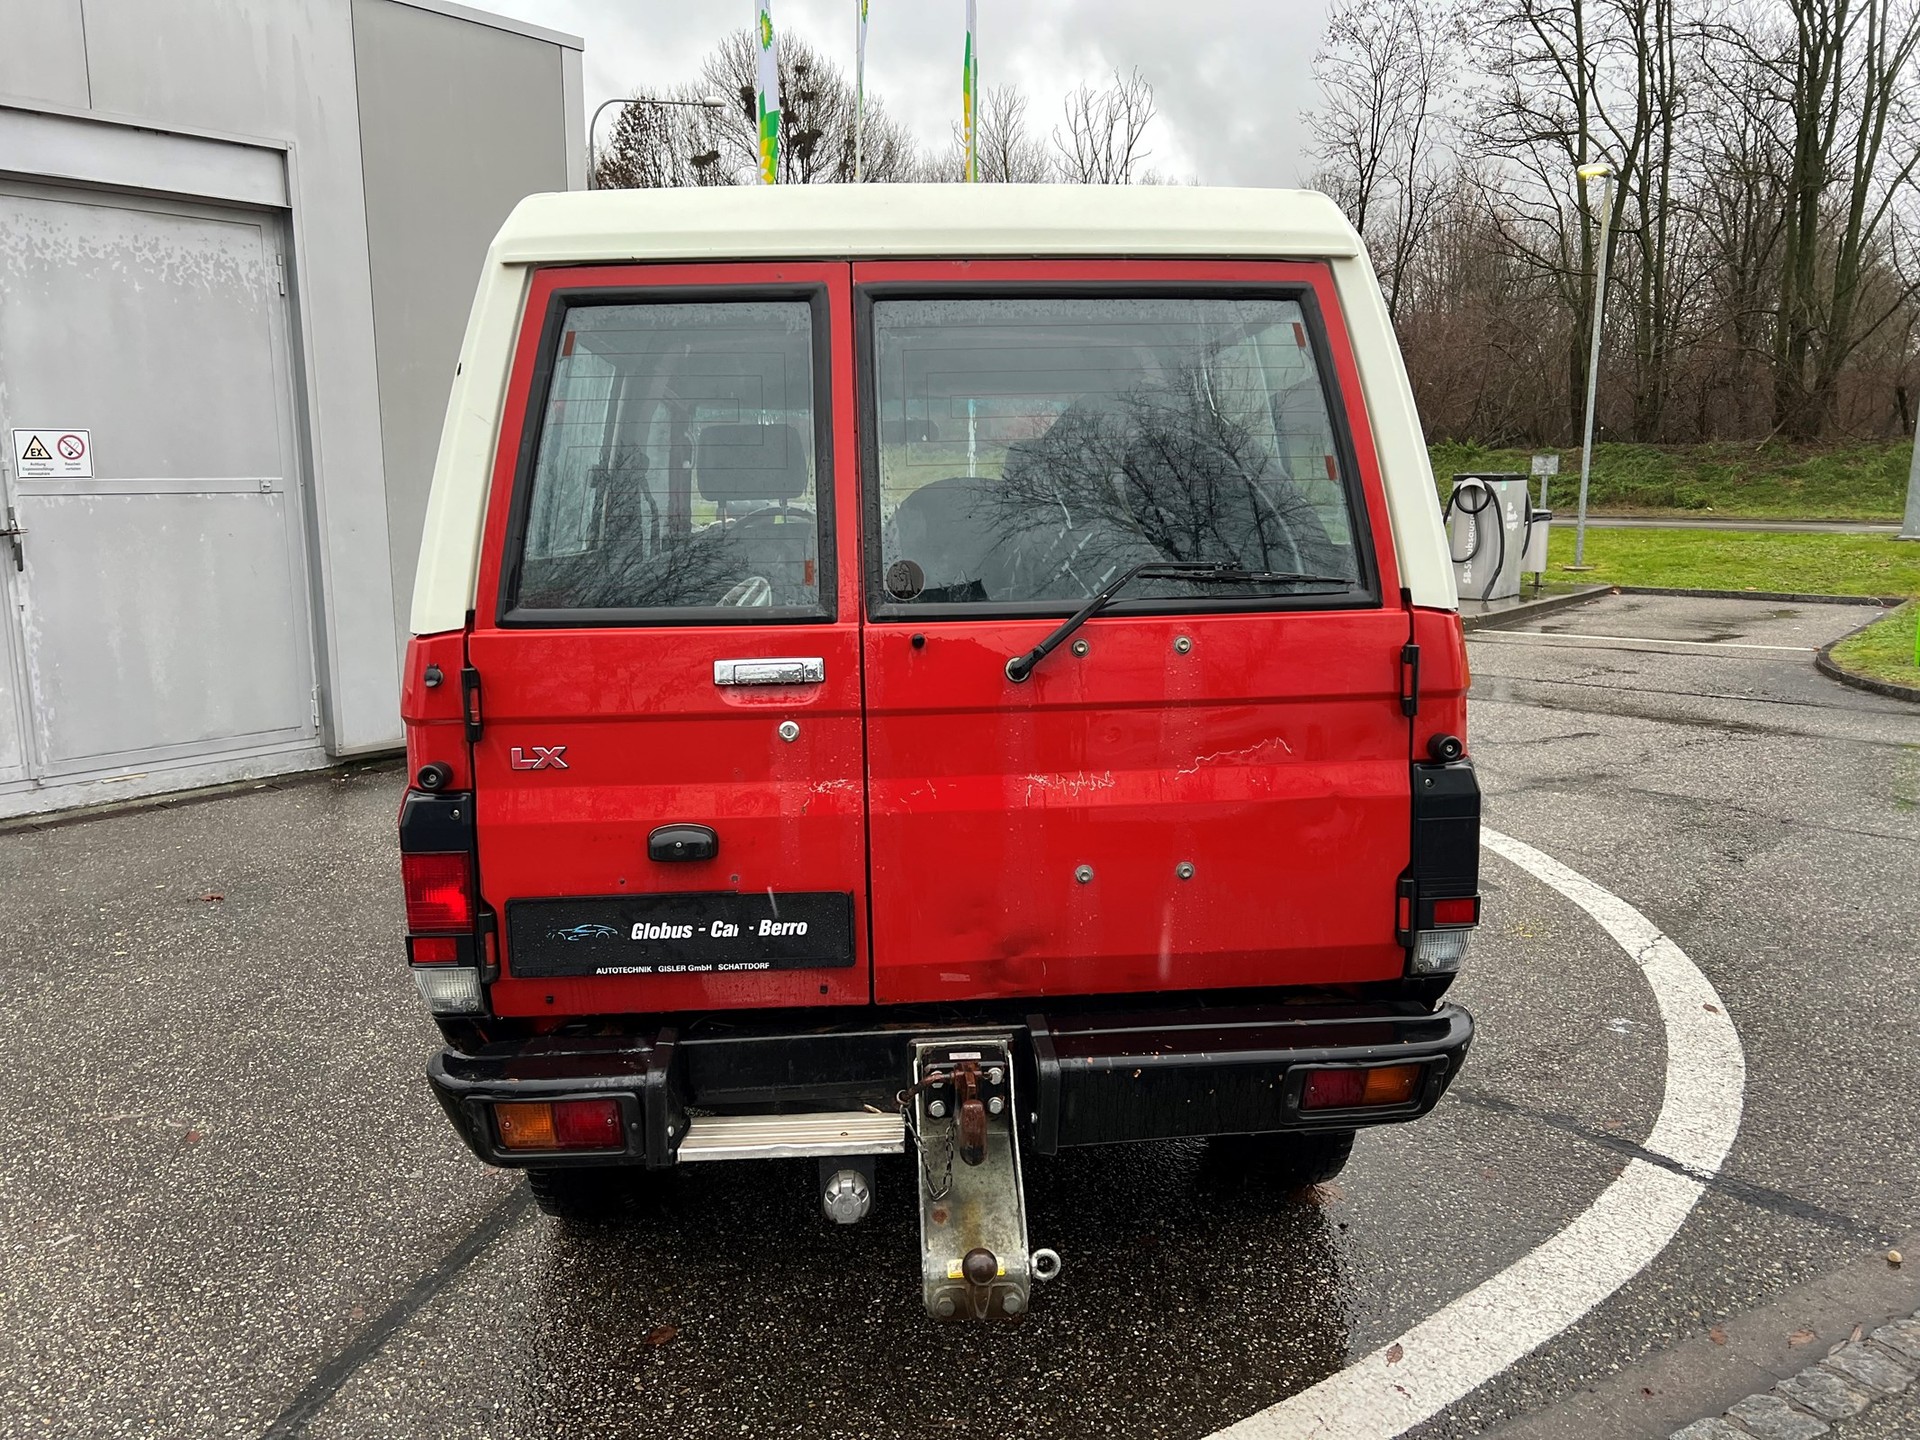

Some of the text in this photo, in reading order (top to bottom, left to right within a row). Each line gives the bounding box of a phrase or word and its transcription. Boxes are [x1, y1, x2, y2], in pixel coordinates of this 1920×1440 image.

[30, 448, 43, 457] EX
[511, 746, 569, 770] LX
[631, 922, 693, 940] Globus
[758, 919, 808, 937] Berro
[596, 962, 770, 975] AUTOTECHNIK GISLER GmbH SCHATTDORF
